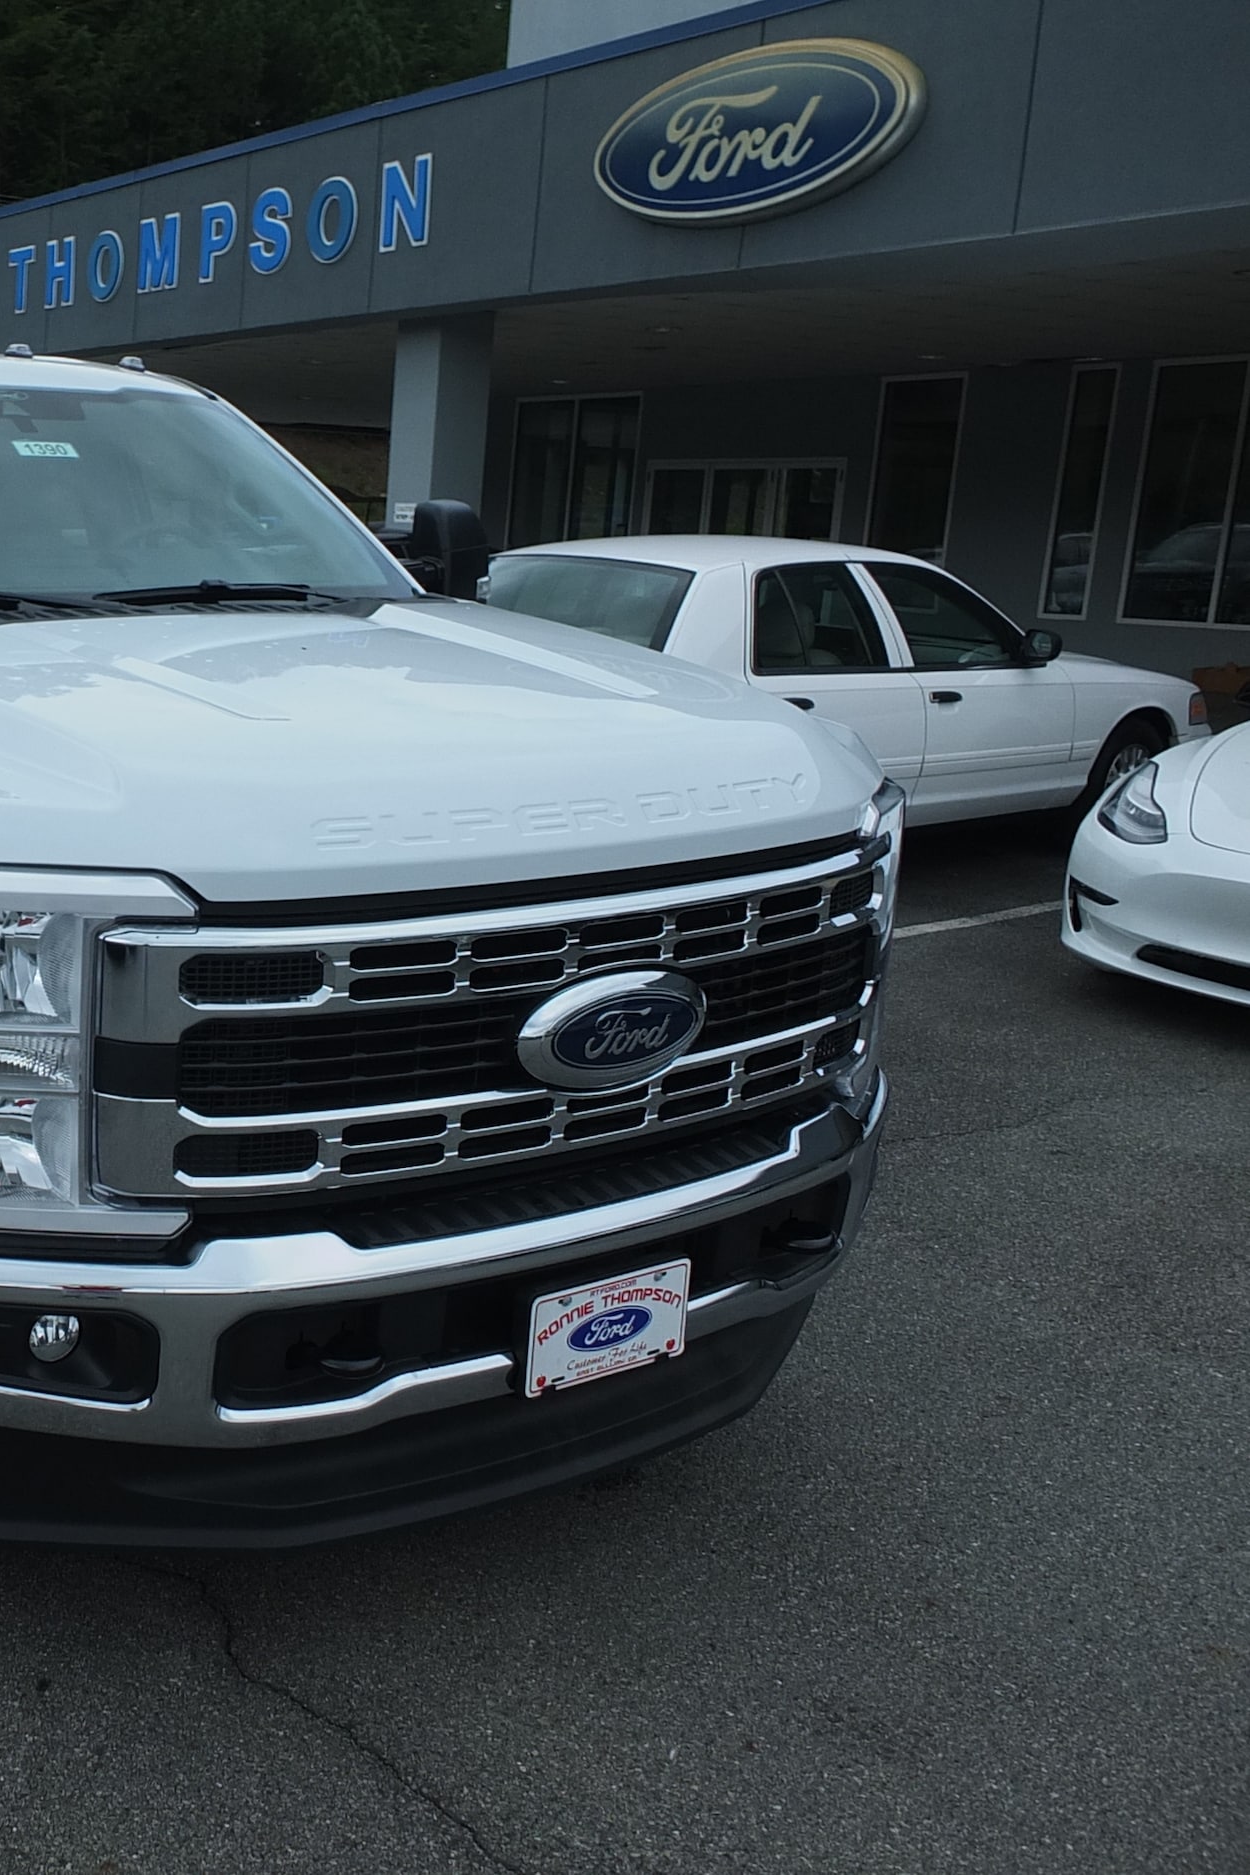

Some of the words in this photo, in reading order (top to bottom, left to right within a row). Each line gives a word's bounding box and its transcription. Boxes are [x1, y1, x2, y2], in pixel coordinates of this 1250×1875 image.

[649, 85, 823, 191] Ford
[8, 152, 434, 314] THOMPSON
[23, 443, 69, 456] 1390
[310, 797, 629, 852] SUPER
[635, 772, 808, 823] DUTY
[583, 1006, 672, 1061] Ford
[536, 1300, 595, 1346] RONNIE
[601, 1288, 682, 1309] THOMPSON
[584, 1312, 636, 1345] Ford
